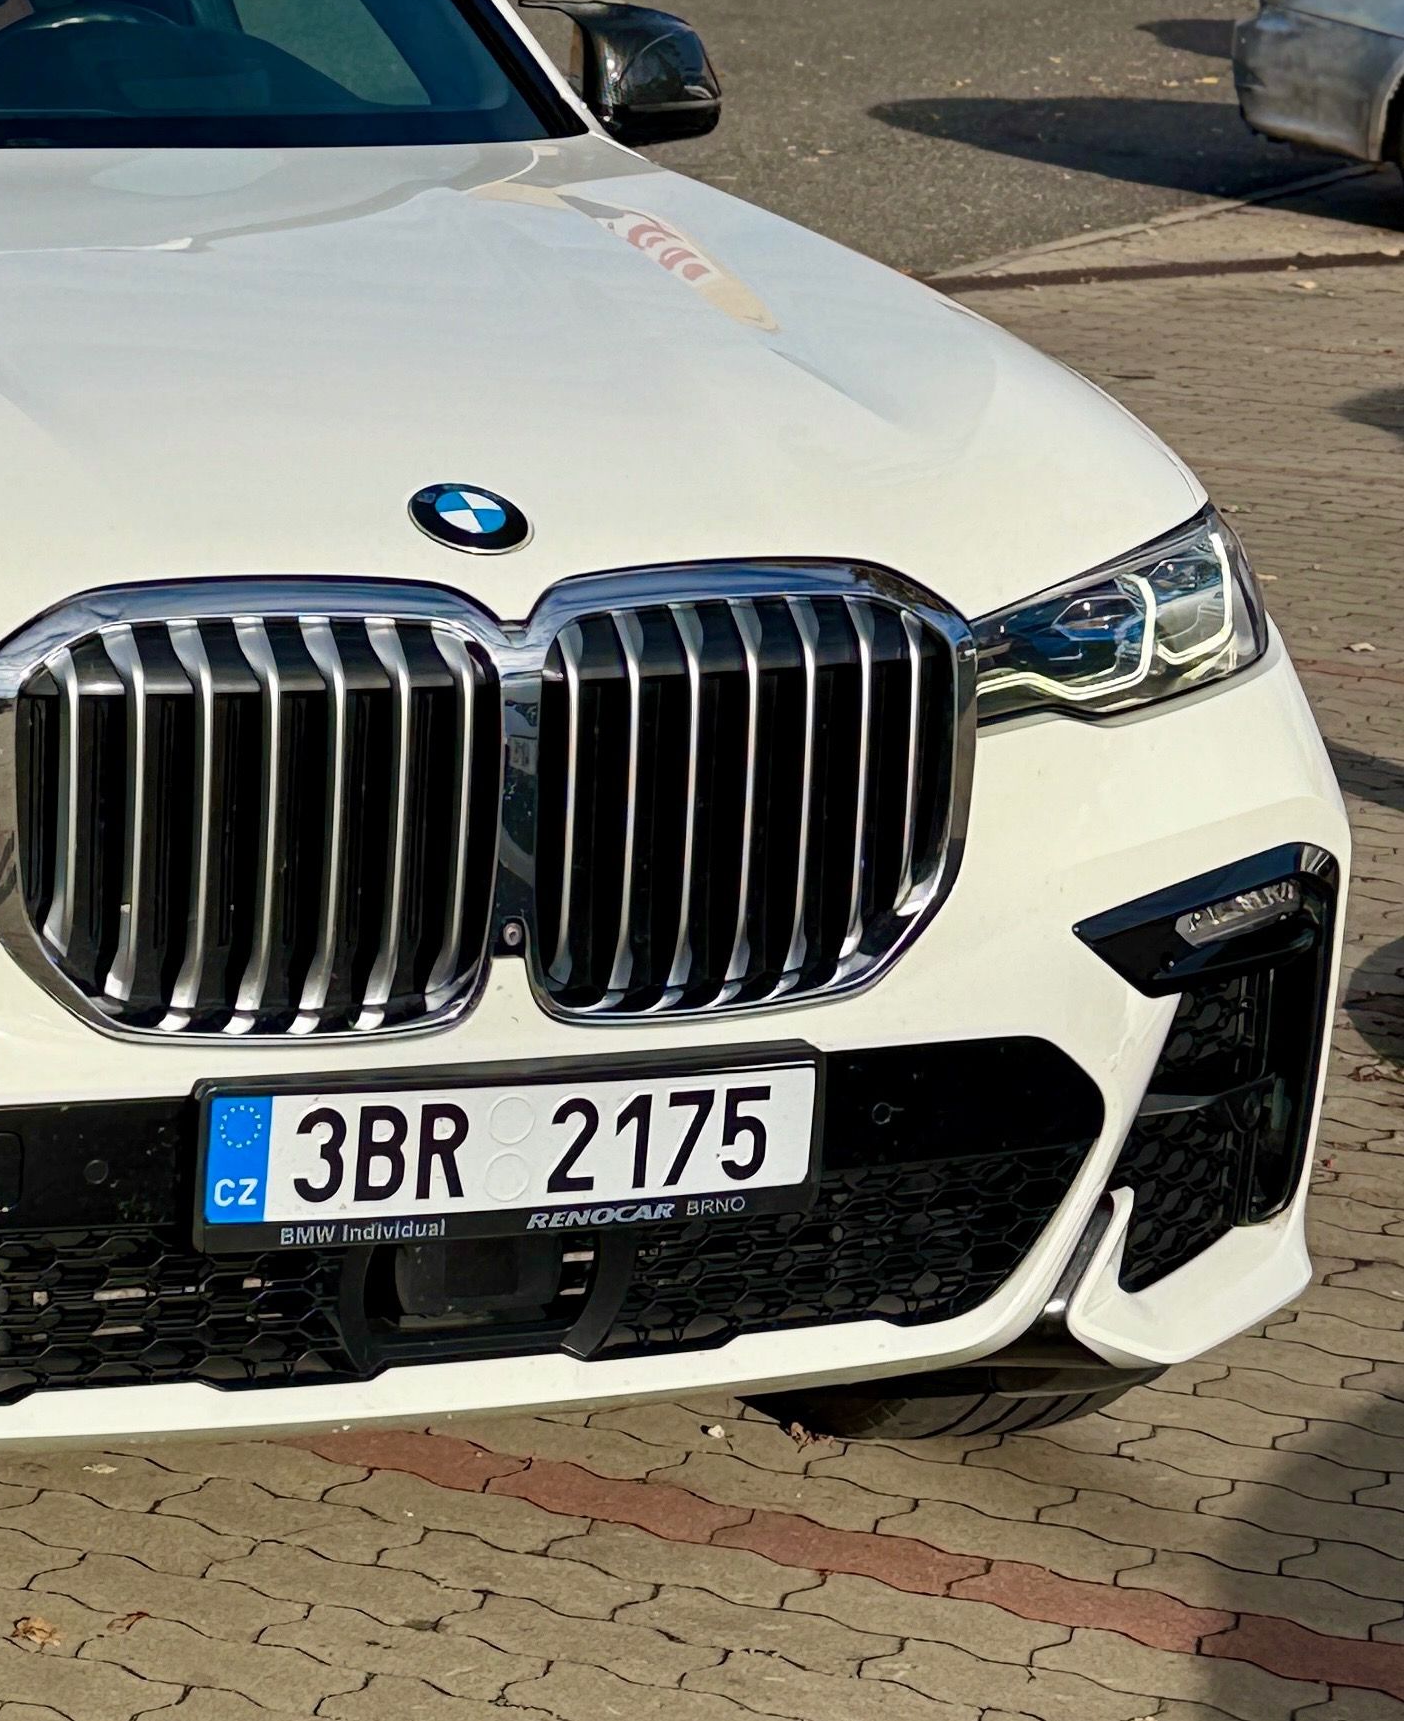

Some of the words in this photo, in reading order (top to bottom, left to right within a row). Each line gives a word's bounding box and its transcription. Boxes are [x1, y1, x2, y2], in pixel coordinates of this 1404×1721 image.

[293, 1103, 469, 1204] 3BR
[547, 1085, 772, 1194] 2175
[213, 1178, 258, 1207] CZ
[526, 1202, 676, 1230] RENOCAR
[686, 1195, 746, 1217] BRNO
[280, 1224, 336, 1246] BMW
[342, 1218, 446, 1243] Individual
